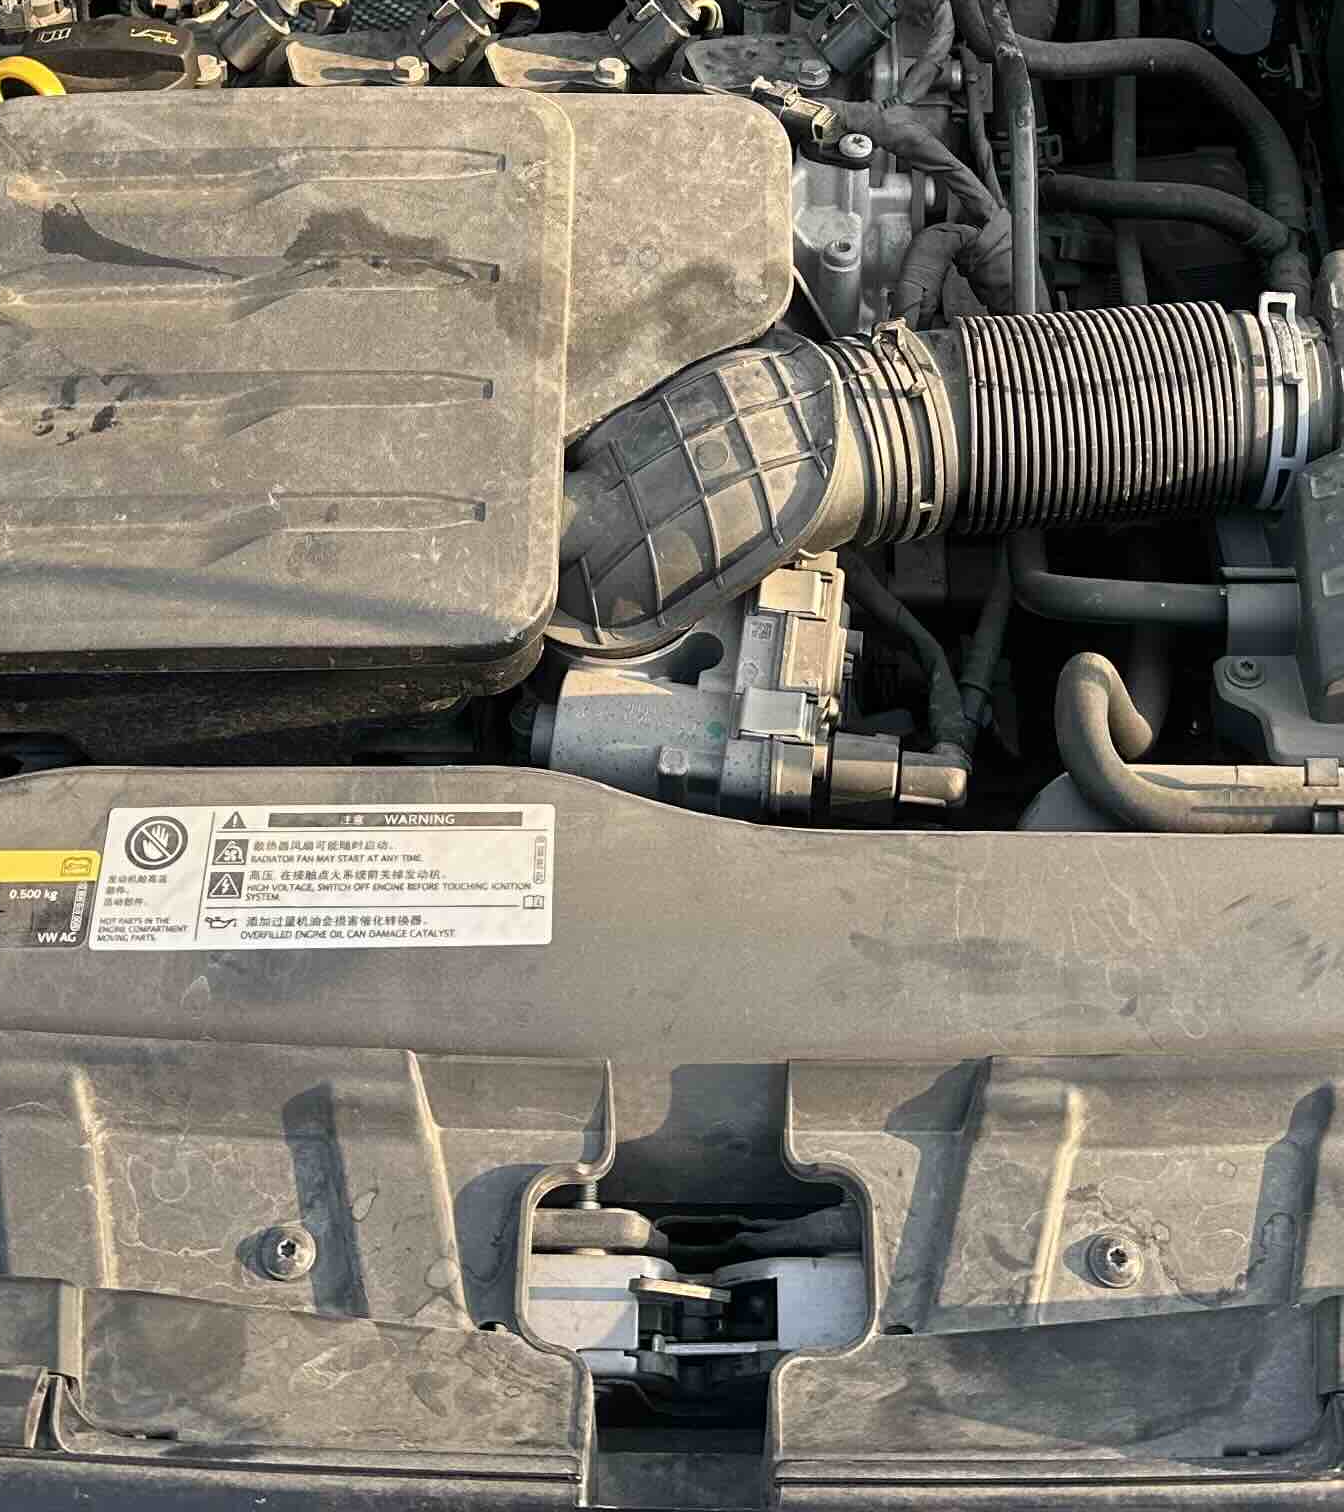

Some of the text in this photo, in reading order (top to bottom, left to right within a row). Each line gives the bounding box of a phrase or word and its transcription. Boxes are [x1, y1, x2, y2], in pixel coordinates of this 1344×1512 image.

[383, 814, 456, 825] WARNING
[251, 855, 294, 863] RADIATOR
[296, 855, 313, 863] FAN
[316, 855, 335, 863] MAY
[337, 854, 364, 863] START
[367, 854, 379, 863] AT
[380, 854, 398, 862] ANY
[246, 884, 269, 892] HIGH
[318, 883, 354, 892] SWITCH
[357, 883, 371, 891] OFF
[373, 883, 404, 891] ENGINE
[407, 883, 439, 891] BEFORE
[442, 882, 488, 891] TOUCHING
[491, 882, 532, 890] IGNITION
[9, 889, 41, 899] 0.500
[44, 888, 58, 902] kg
[154, 917, 170, 925] THE
[37, 931, 77, 943] VW AG
[97, 934, 128, 942] MOVING
[240, 930, 292, 939] OVERFILLED
[295, 930, 326, 939] ENGINE
[329, 930, 344, 938] OIL
[346, 930, 365, 938] CAN
[368, 929, 407, 938] DAMAGE
